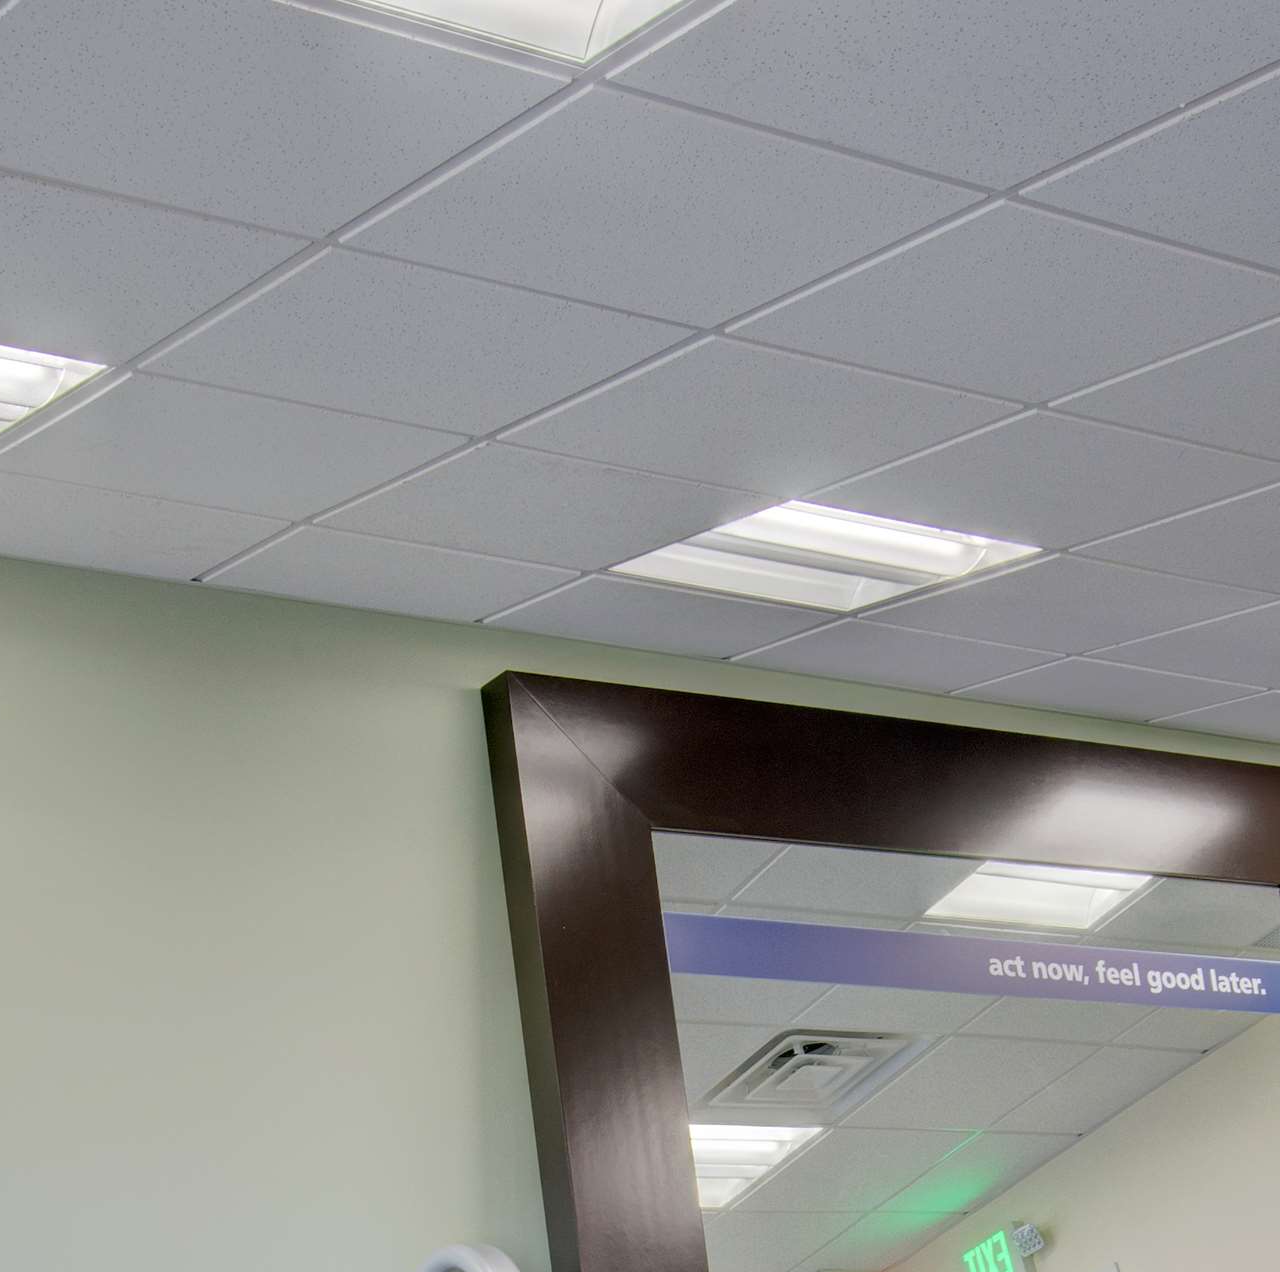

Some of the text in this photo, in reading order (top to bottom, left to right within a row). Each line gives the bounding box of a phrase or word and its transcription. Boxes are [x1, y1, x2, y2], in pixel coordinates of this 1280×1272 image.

[989, 956, 1267, 995] act now, feel good later.
